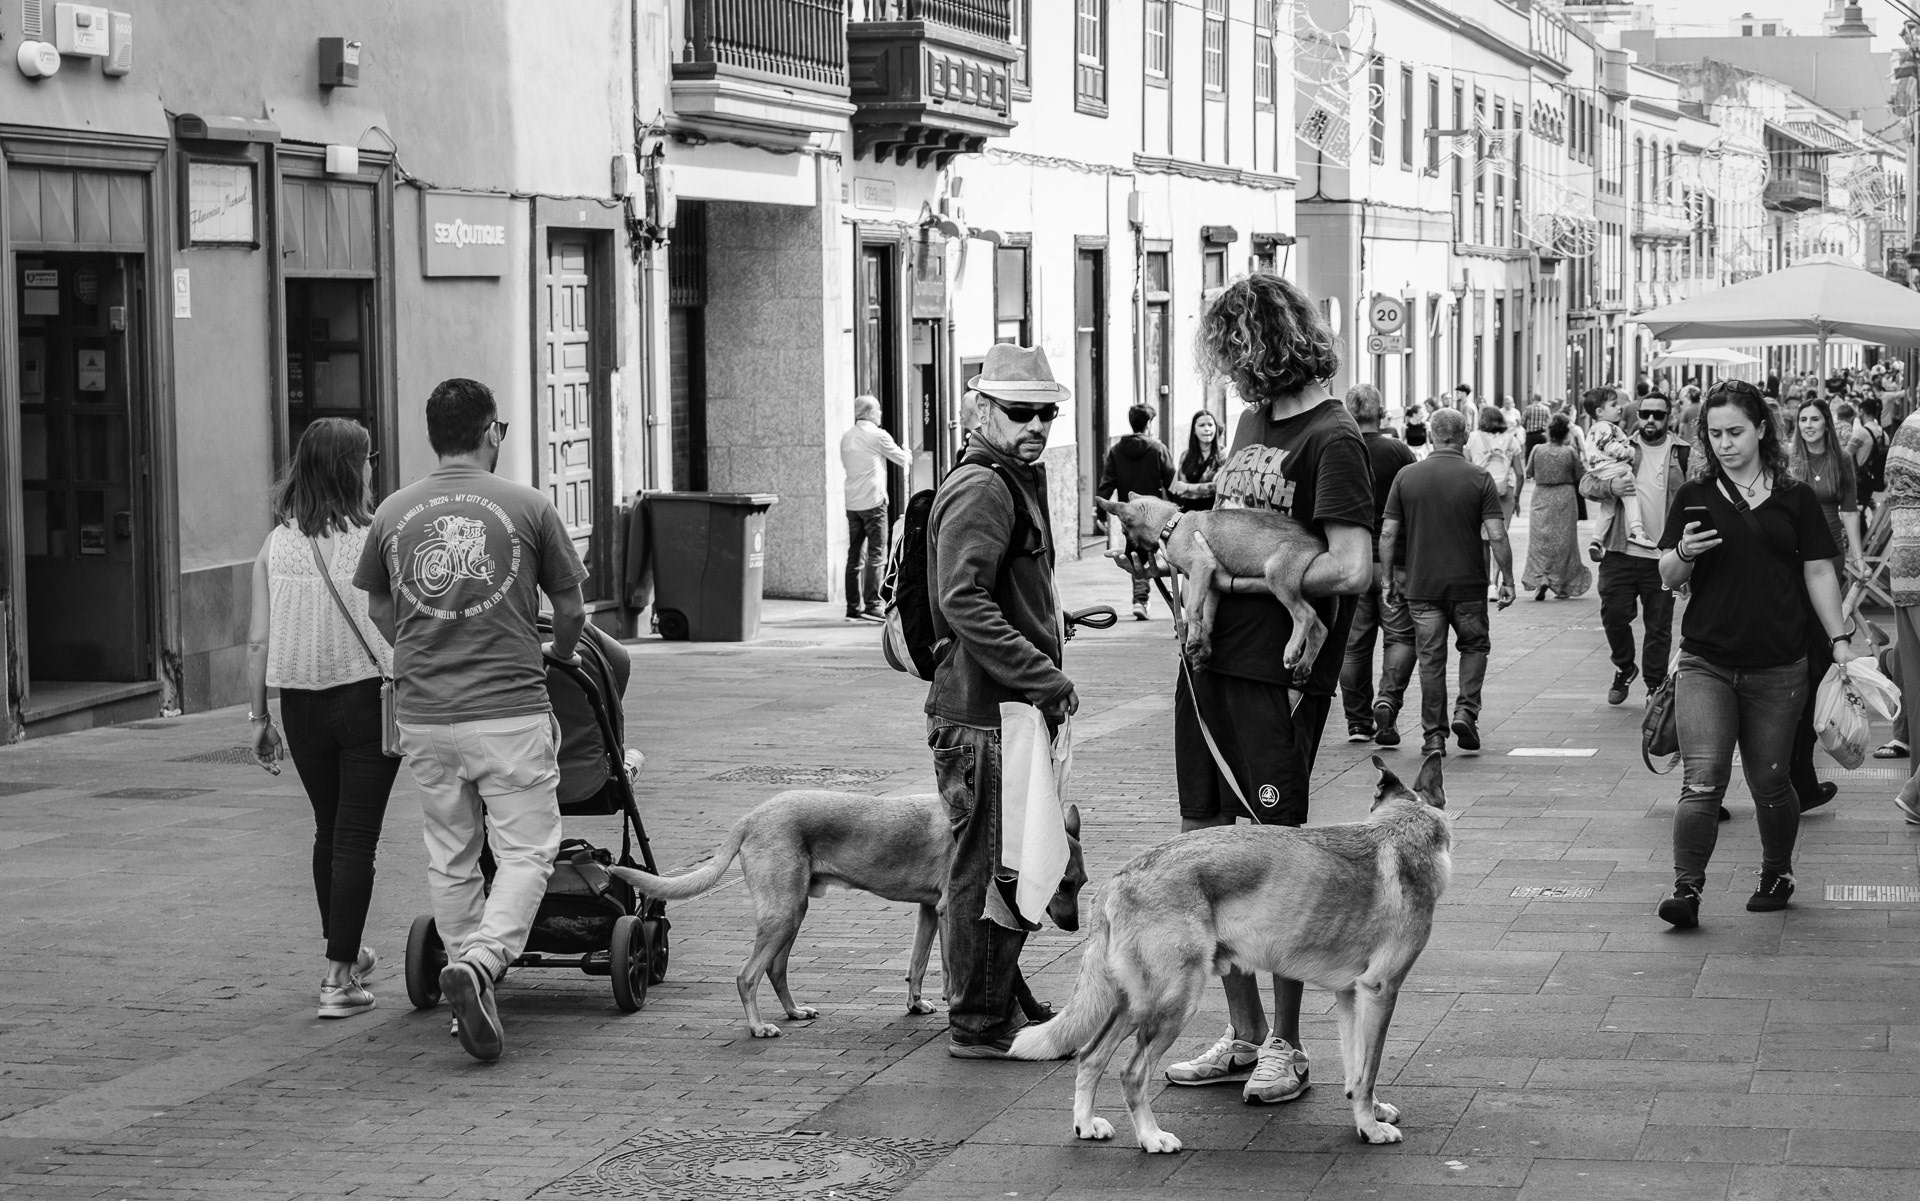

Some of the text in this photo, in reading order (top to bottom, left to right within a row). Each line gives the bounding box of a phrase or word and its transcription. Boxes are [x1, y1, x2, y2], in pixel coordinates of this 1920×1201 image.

[1377, 309, 1397, 321] 20
[466, 495, 480, 504] CITY
[480, 497, 488, 506] IS
[403, 504, 424, 522] ANGLES
[487, 502, 516, 534] ASTOUNDING
[396, 521, 406, 531] ALL
[512, 545, 521, 558] YOU
[492, 592, 503, 604] GET
[416, 602, 456, 619] INTERNATIONAL
[464, 605, 483, 617] KNOW
[483, 601, 492, 609] TO
